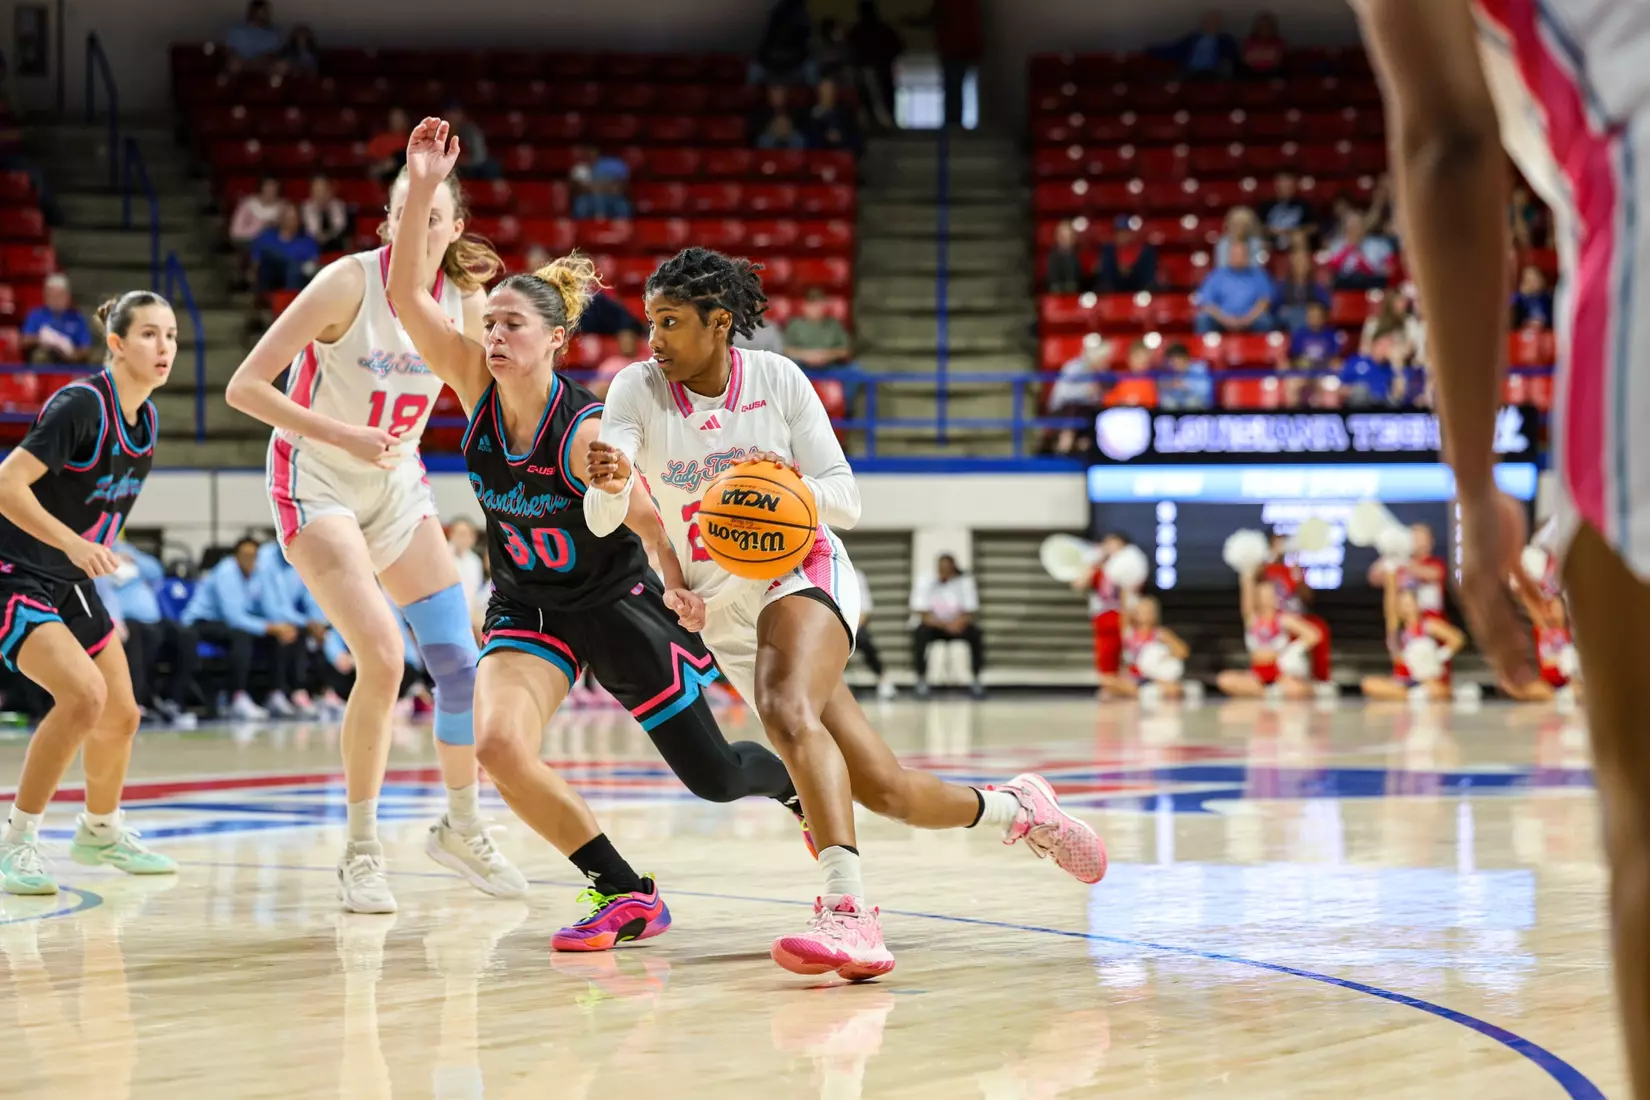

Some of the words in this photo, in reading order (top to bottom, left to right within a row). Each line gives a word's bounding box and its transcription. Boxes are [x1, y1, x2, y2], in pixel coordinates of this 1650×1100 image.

[367, 390, 429, 438] 18
[741, 399, 767, 413] C-USA
[526, 464, 556, 476] C-US
[660, 459, 702, 494] Lady
[720, 488, 781, 513] NCAA
[499, 520, 576, 573] 30
[707, 520, 786, 552] Wilson
